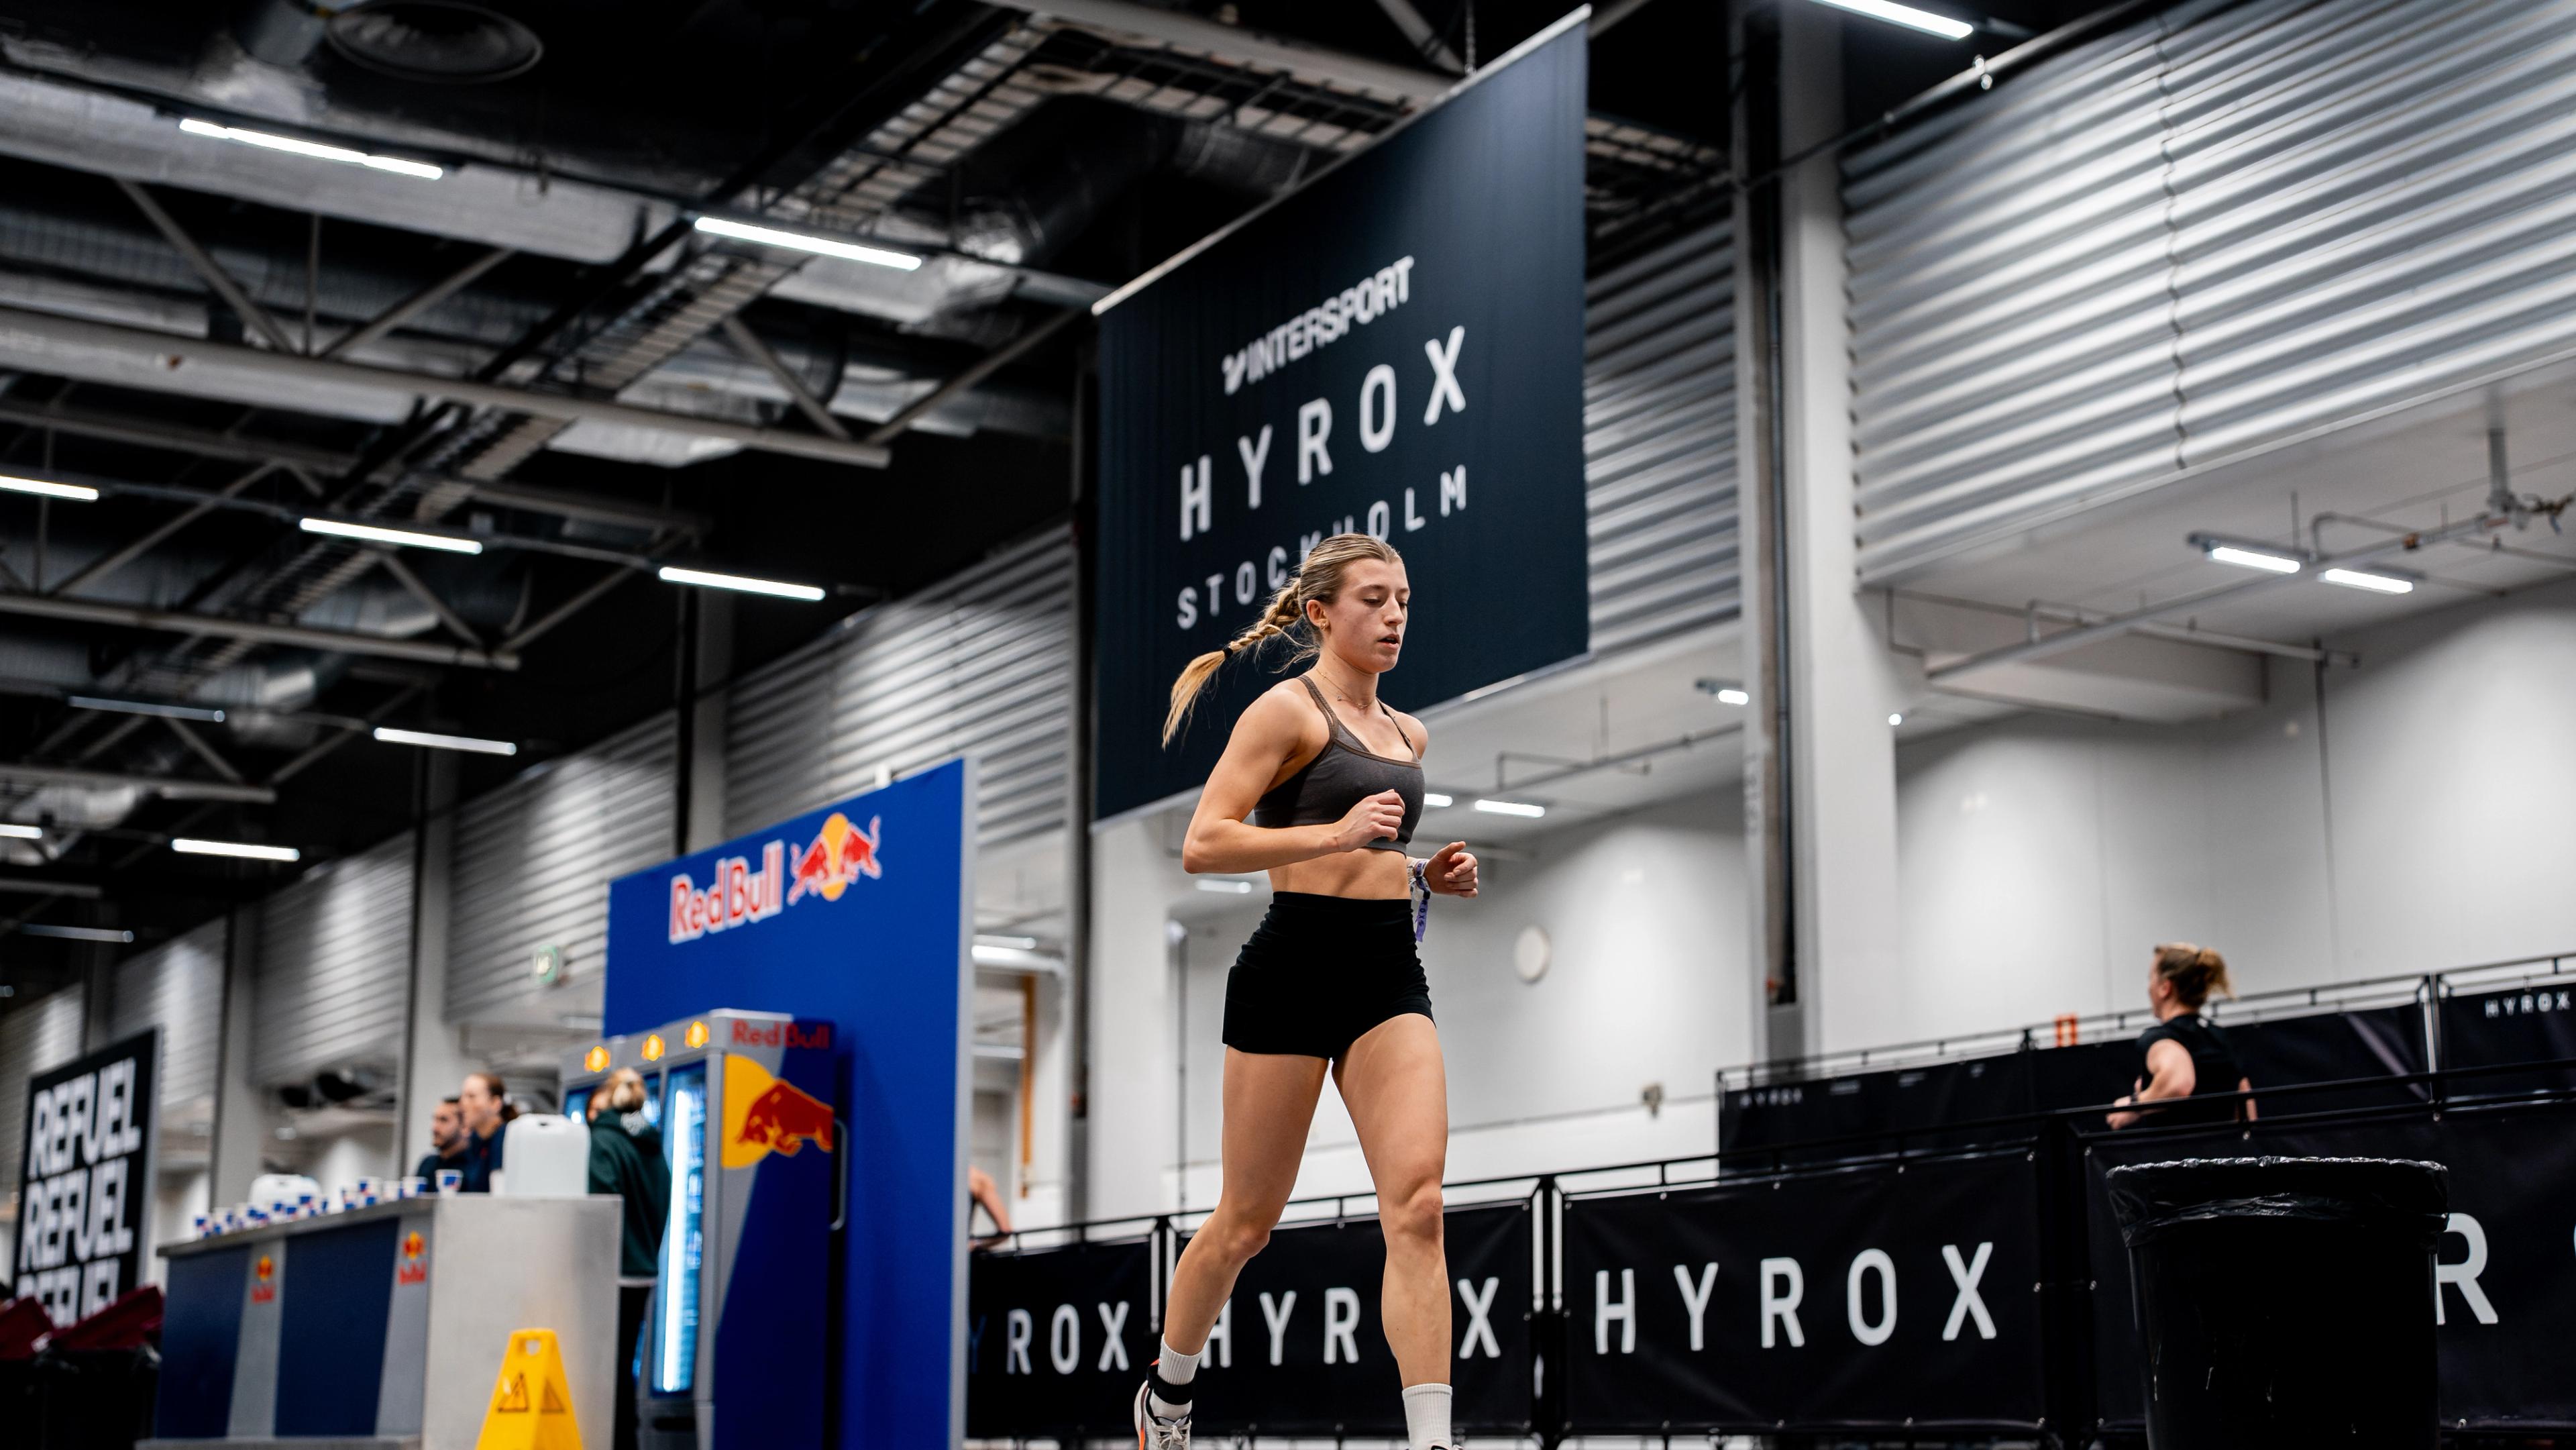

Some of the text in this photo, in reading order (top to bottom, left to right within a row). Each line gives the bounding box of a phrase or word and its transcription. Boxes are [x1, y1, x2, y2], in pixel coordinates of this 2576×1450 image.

[1244, 255, 1414, 385] INTERSPORT
[1179, 325, 1467, 541] HYROX
[731, 1019, 830, 1049] Red Bull
[2485, 990, 2571, 1019] HYROX
[28, 1057, 142, 1180] REFUEL
[20, 1159, 133, 1274] REFUEL
[1200, 1276, 1501, 1369] HYRX
[1595, 1241, 1998, 1355] HYROX
